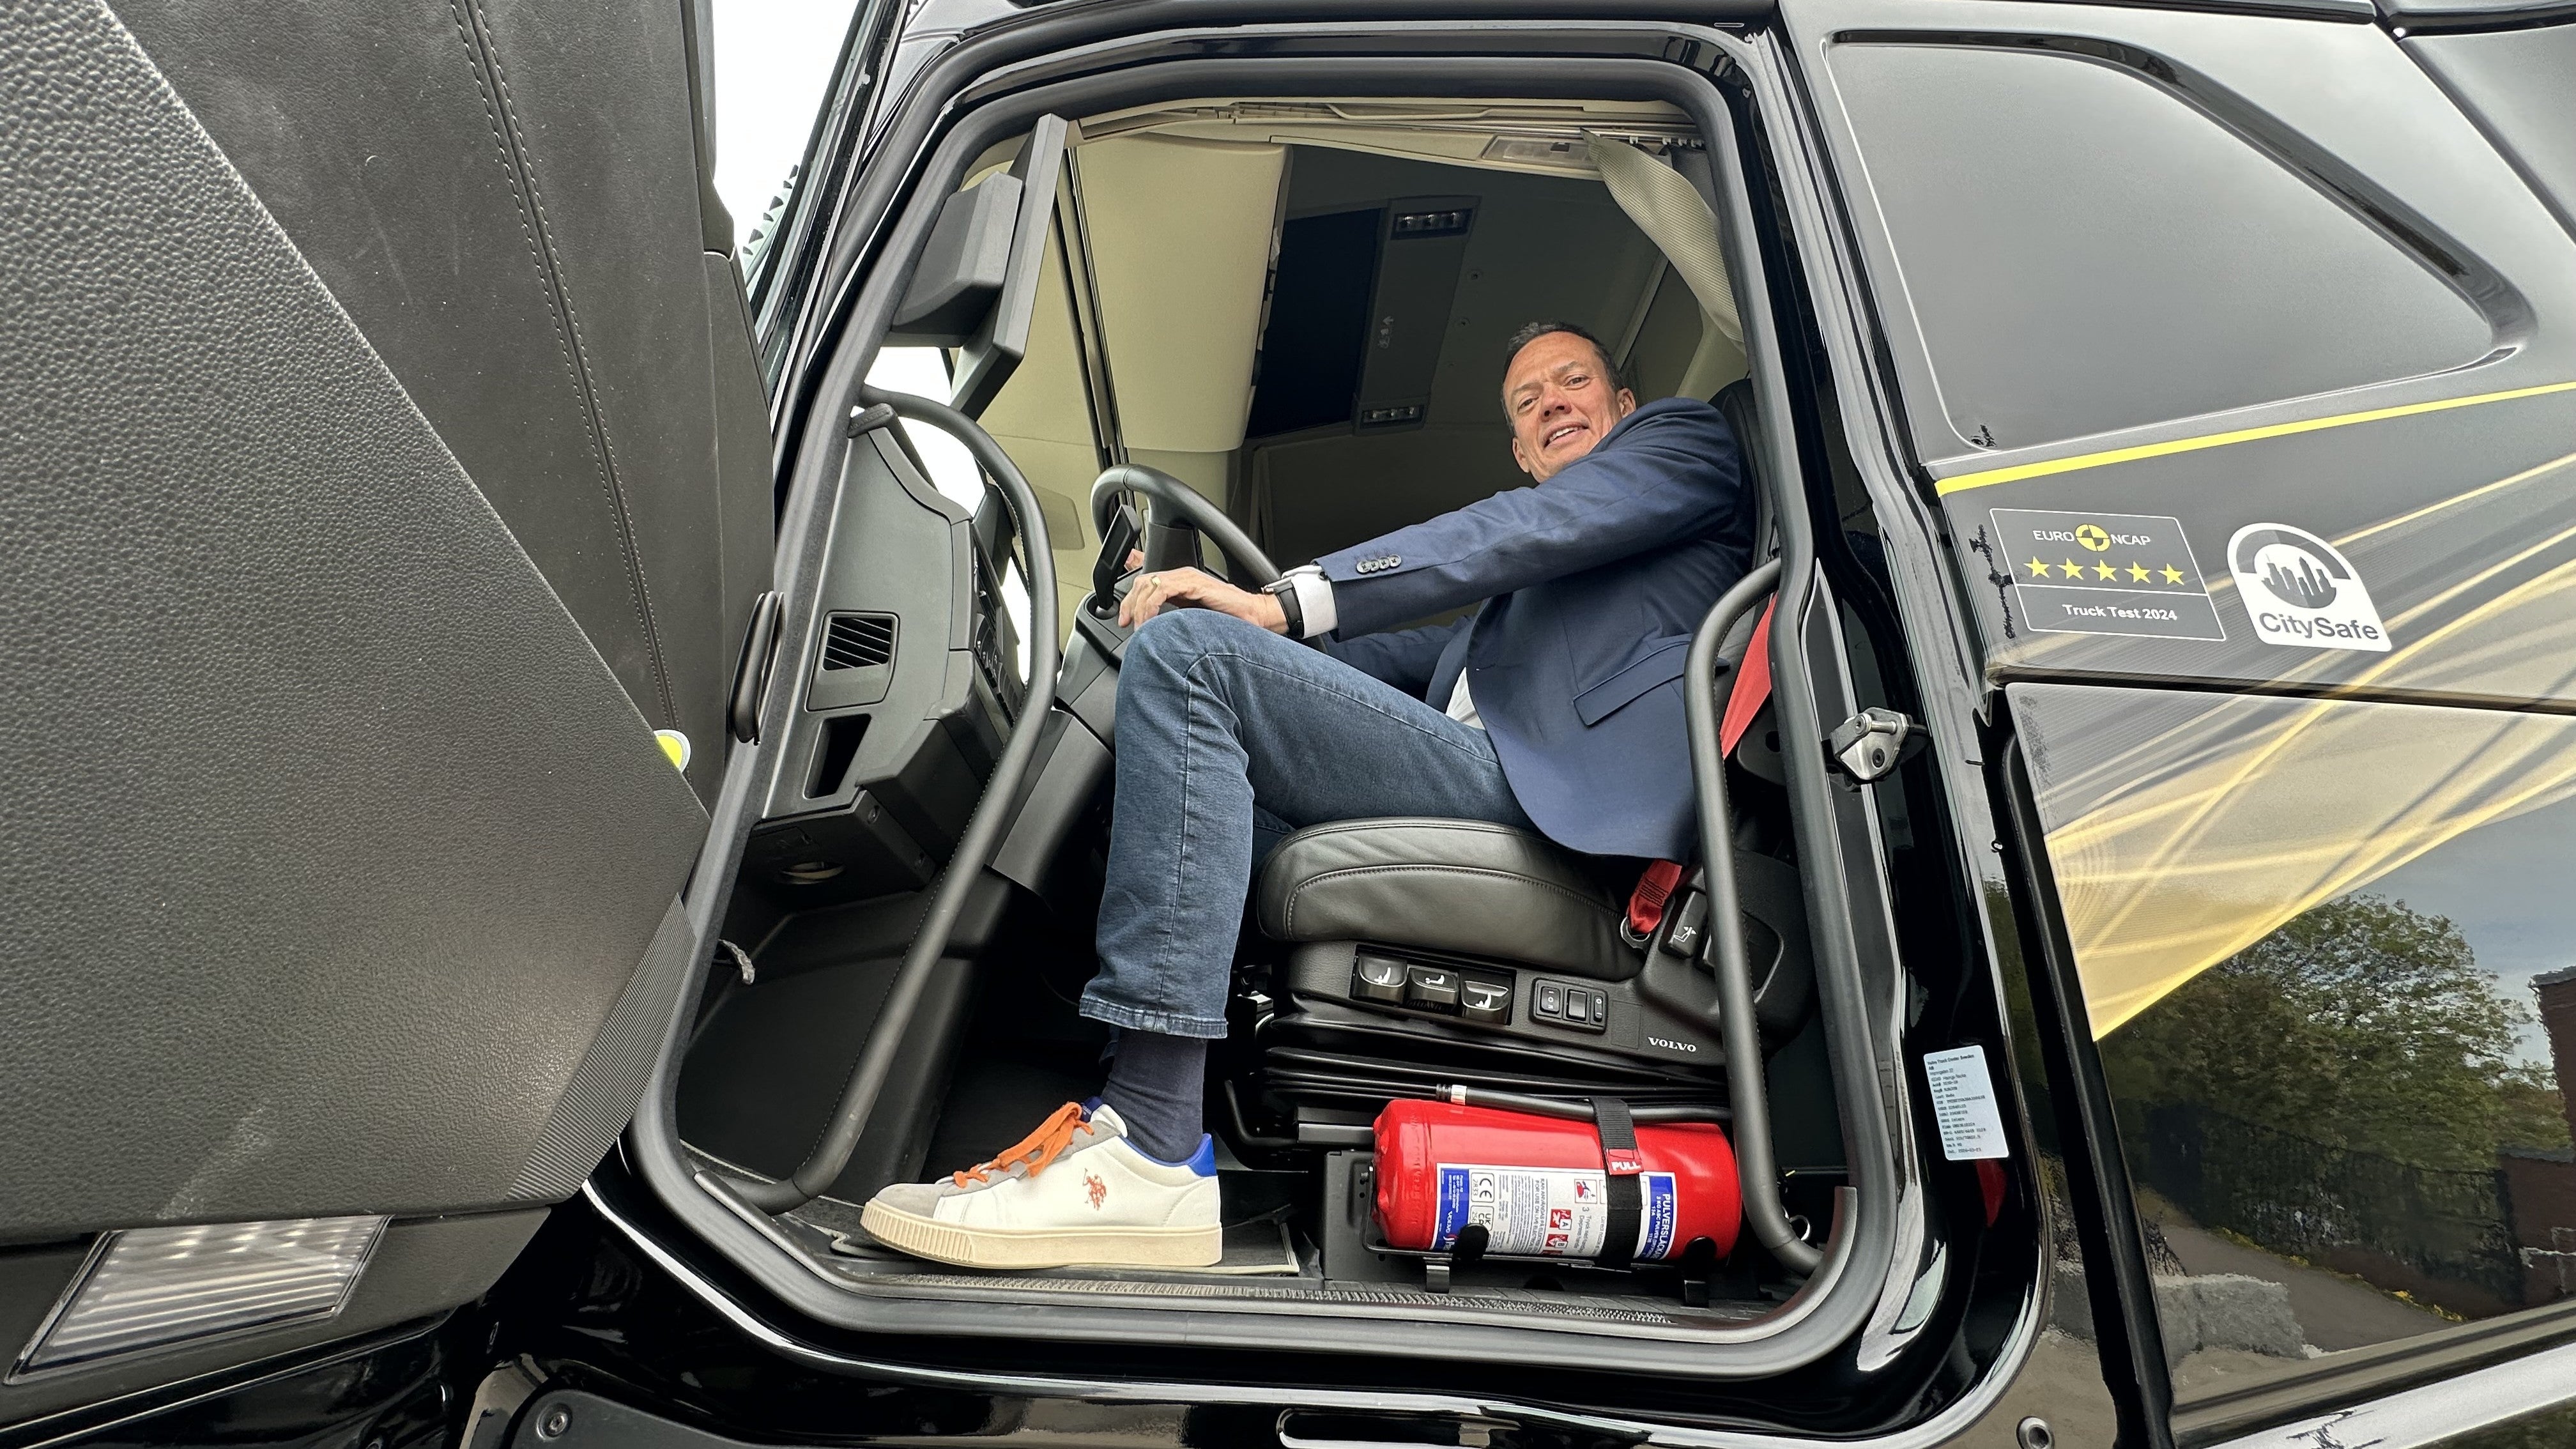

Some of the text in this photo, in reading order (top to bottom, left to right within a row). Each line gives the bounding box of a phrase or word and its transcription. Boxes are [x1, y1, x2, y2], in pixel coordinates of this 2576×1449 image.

[2033, 530, 2150, 545] EURO NCAP
[2062, 604, 2177, 620] Truck Test 2024
[2259, 612, 2379, 640] CitySafe
[1648, 1036, 1697, 1052] VOLVO
[1611, 1161, 1641, 1172] PULL
[1479, 1178, 1492, 1199] CE
[1484, 1213, 1491, 1225] UK
